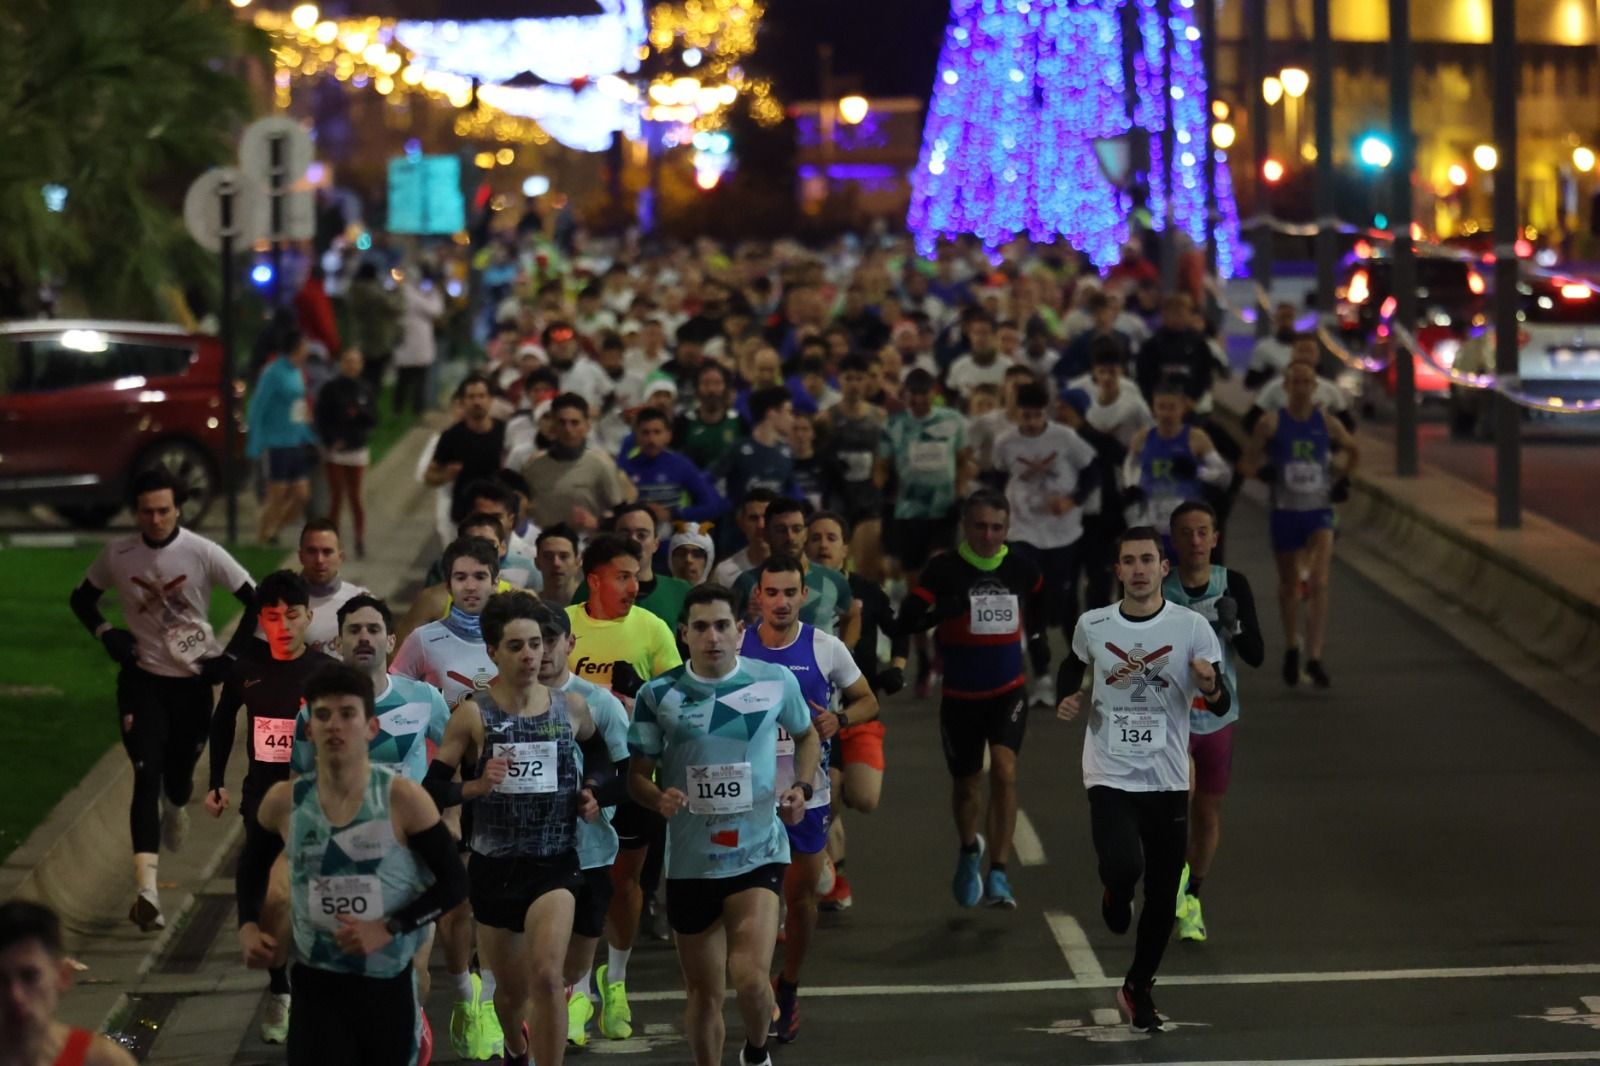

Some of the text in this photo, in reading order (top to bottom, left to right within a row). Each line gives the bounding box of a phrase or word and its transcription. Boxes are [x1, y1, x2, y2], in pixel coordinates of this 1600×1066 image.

[977, 609, 1012, 622] 1059
[1121, 729, 1152, 743] 134
[508, 761, 543, 777] 572
[697, 782, 741, 799] 1149
[322, 896, 367, 915] 520
